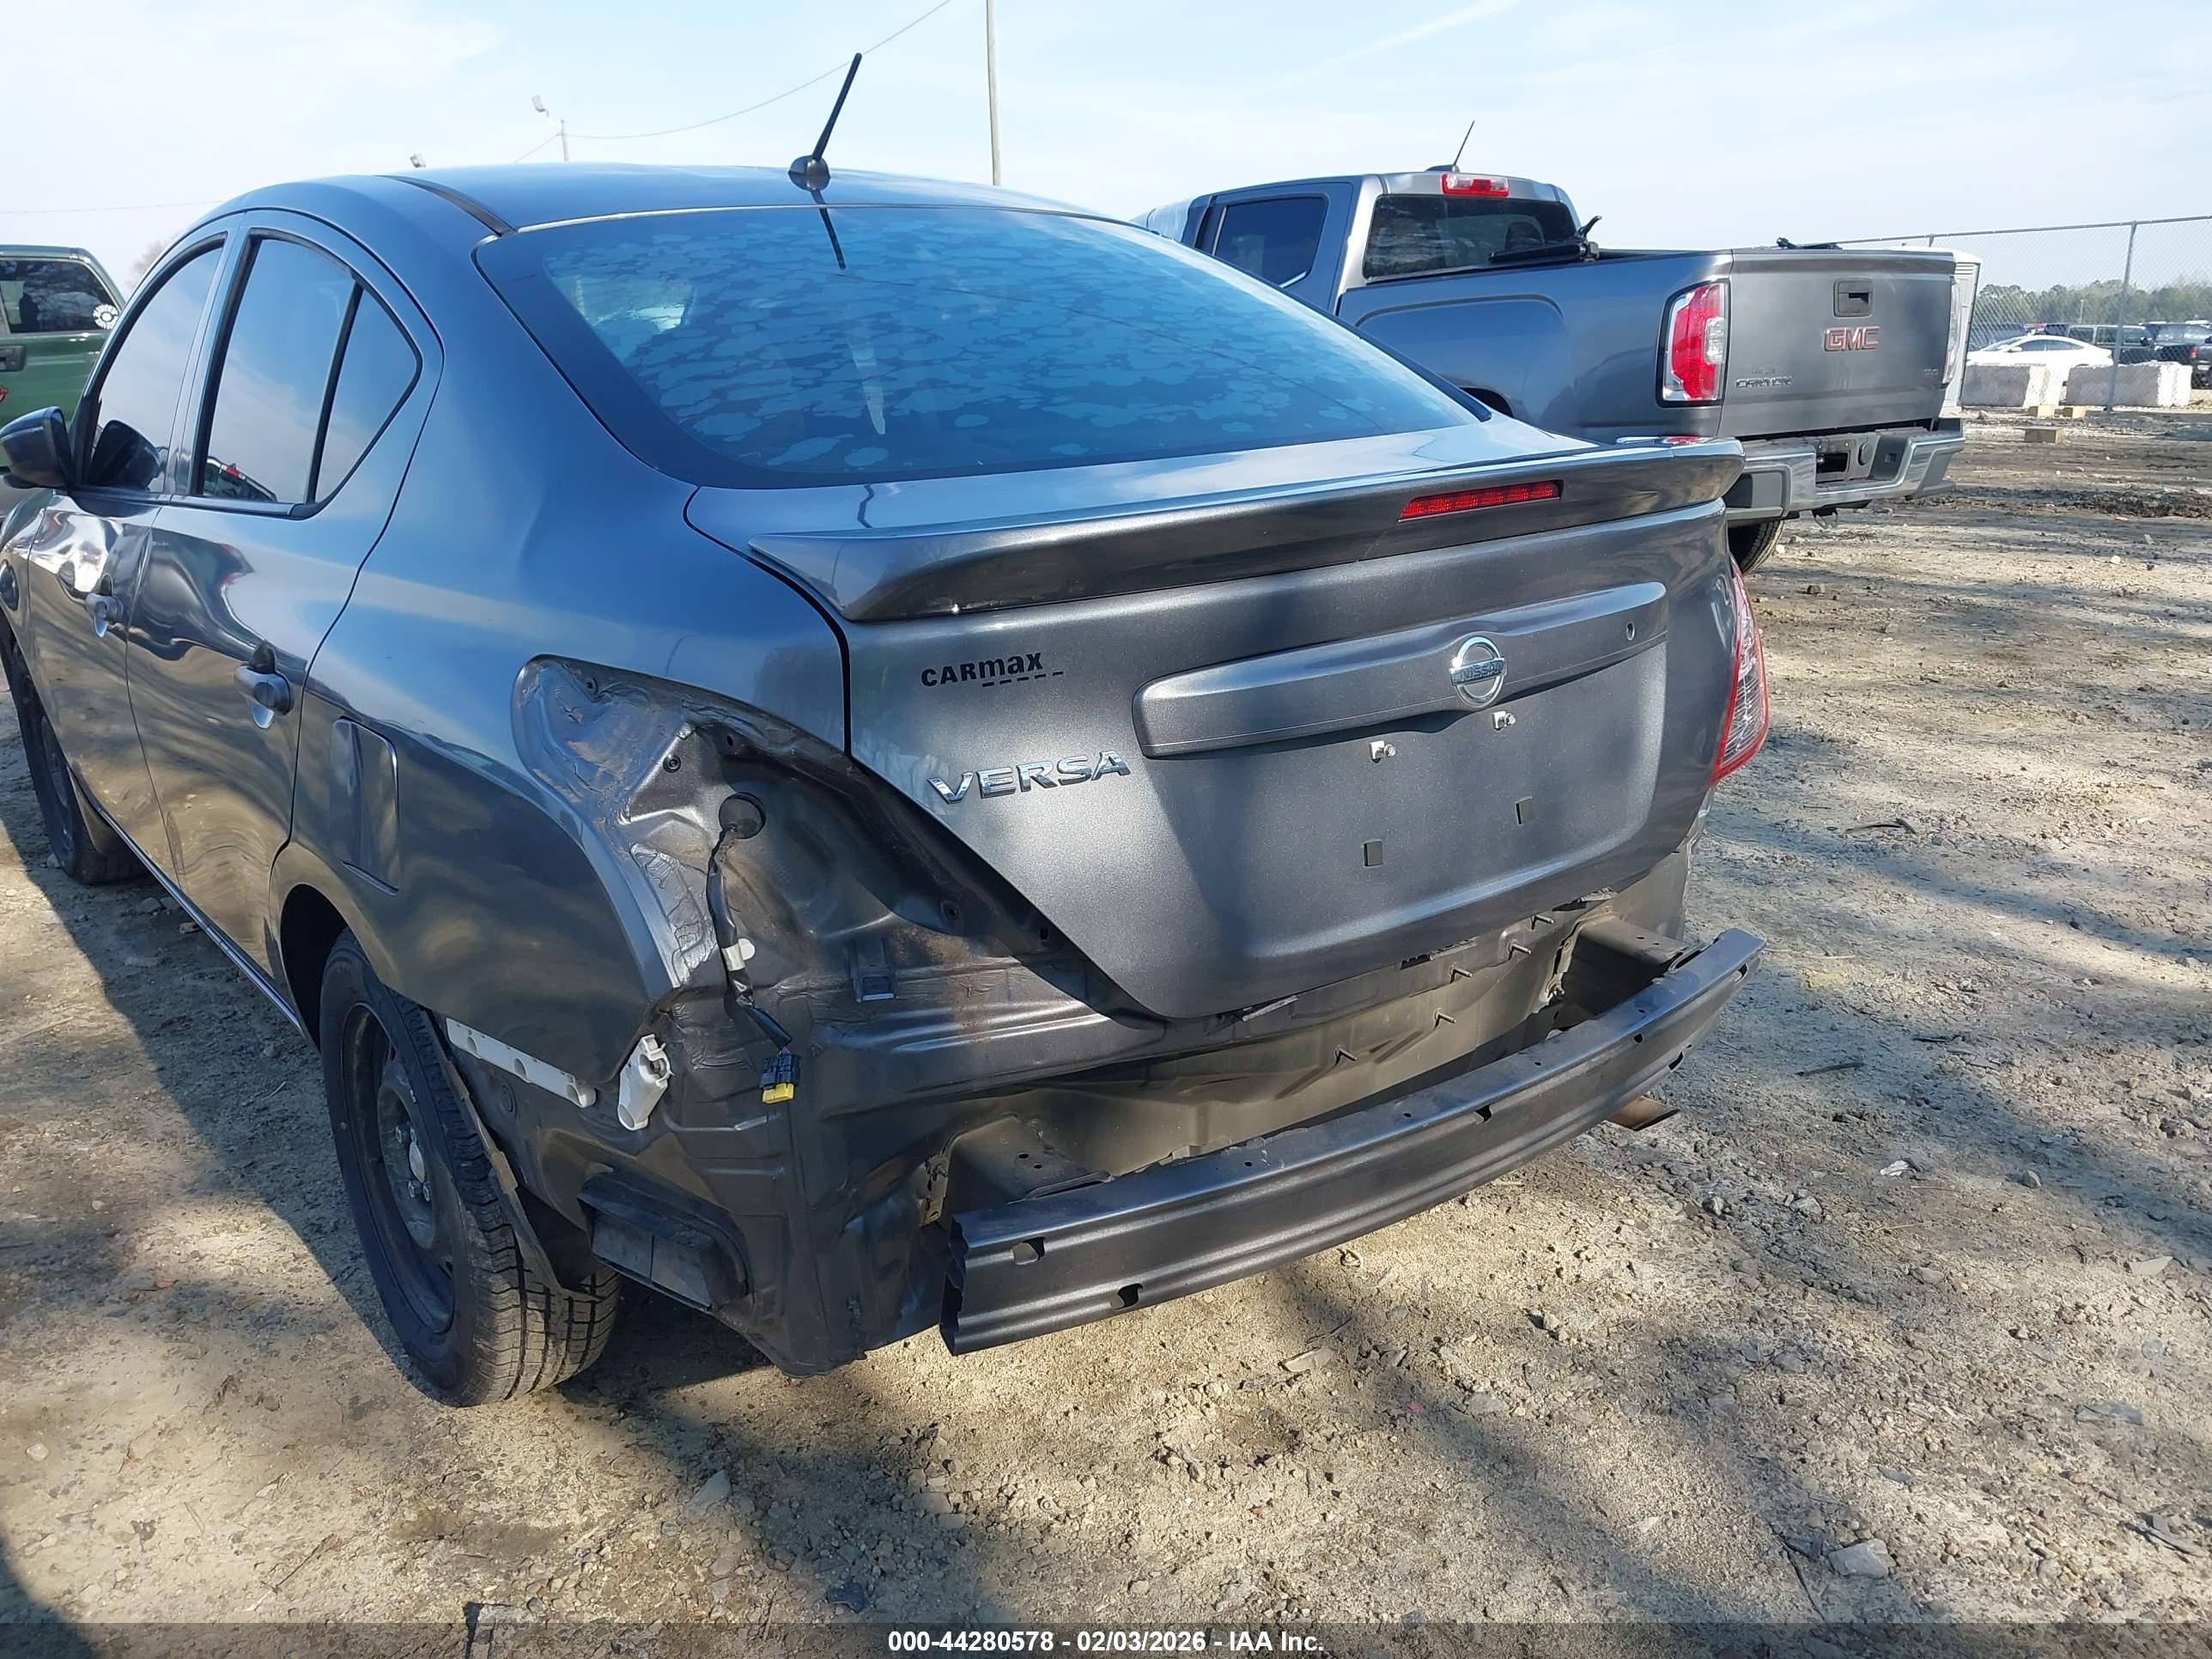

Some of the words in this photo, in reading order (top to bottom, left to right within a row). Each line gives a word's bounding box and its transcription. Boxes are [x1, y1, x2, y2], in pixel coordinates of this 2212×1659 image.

[1824, 326, 1881, 351] GMC
[1460, 660, 1502, 682] NISSAN
[927, 749, 1131, 805] VERSA
